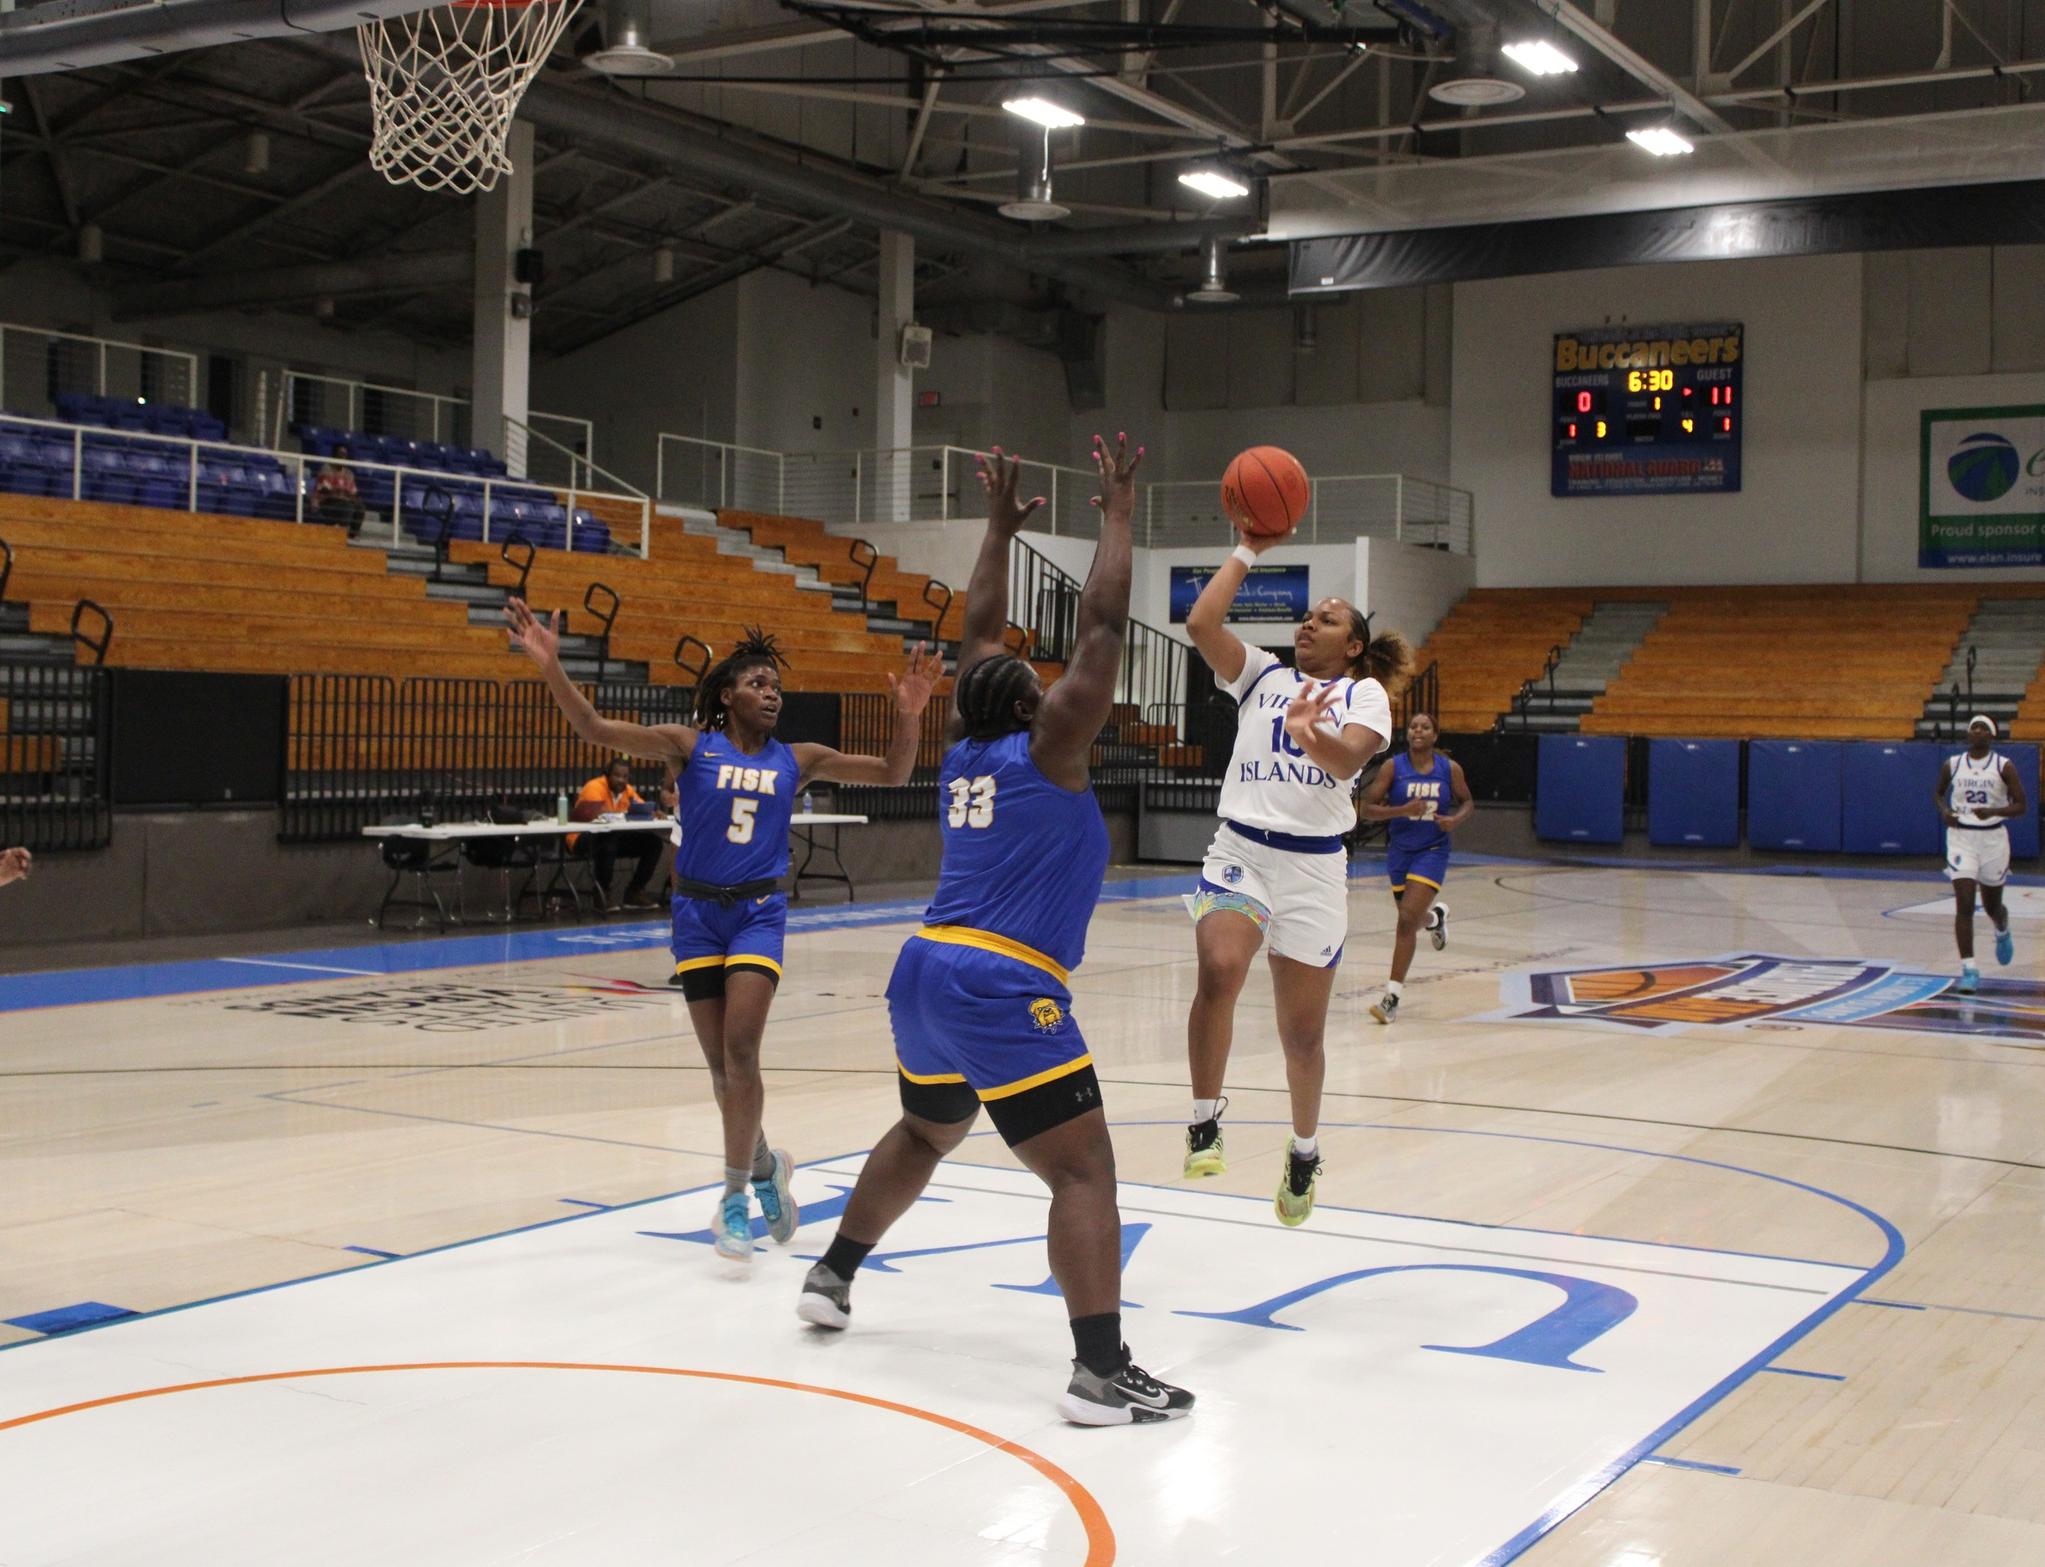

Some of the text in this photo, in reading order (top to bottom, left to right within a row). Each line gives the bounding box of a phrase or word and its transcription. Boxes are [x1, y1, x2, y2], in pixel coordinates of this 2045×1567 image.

[1556, 336, 1740, 371] Buccaneers
[1628, 370, 1674, 392] 6:30
[1697, 368, 1733, 381] GUEST
[1577, 391, 1592, 412] 0
[1654, 396, 1661, 410] 1
[1711, 386, 1733, 405] 11
[1568, 423, 1576, 438] 1
[1681, 419, 1693, 433] 4
[1723, 416, 1731, 432] 1
[1931, 523, 1974, 537] Proud
[1977, 525, 2035, 538] sponsor
[1259, 693, 1343, 728] VIN
[716, 764, 779, 796] FISK
[1240, 761, 1337, 790] ISLANDS
[1956, 778, 1996, 789] VIRGIN
[1407, 782, 1440, 798] FISK
[1965, 790, 1987, 804] 23
[948, 774, 997, 829] 33
[1409, 800, 1438, 821] 2
[726, 797, 760, 845] 5
[274, 988, 542, 1020] VIRGIN
[341, 993, 601, 1026] STATES
[415, 1000, 670, 1033] UNITED
